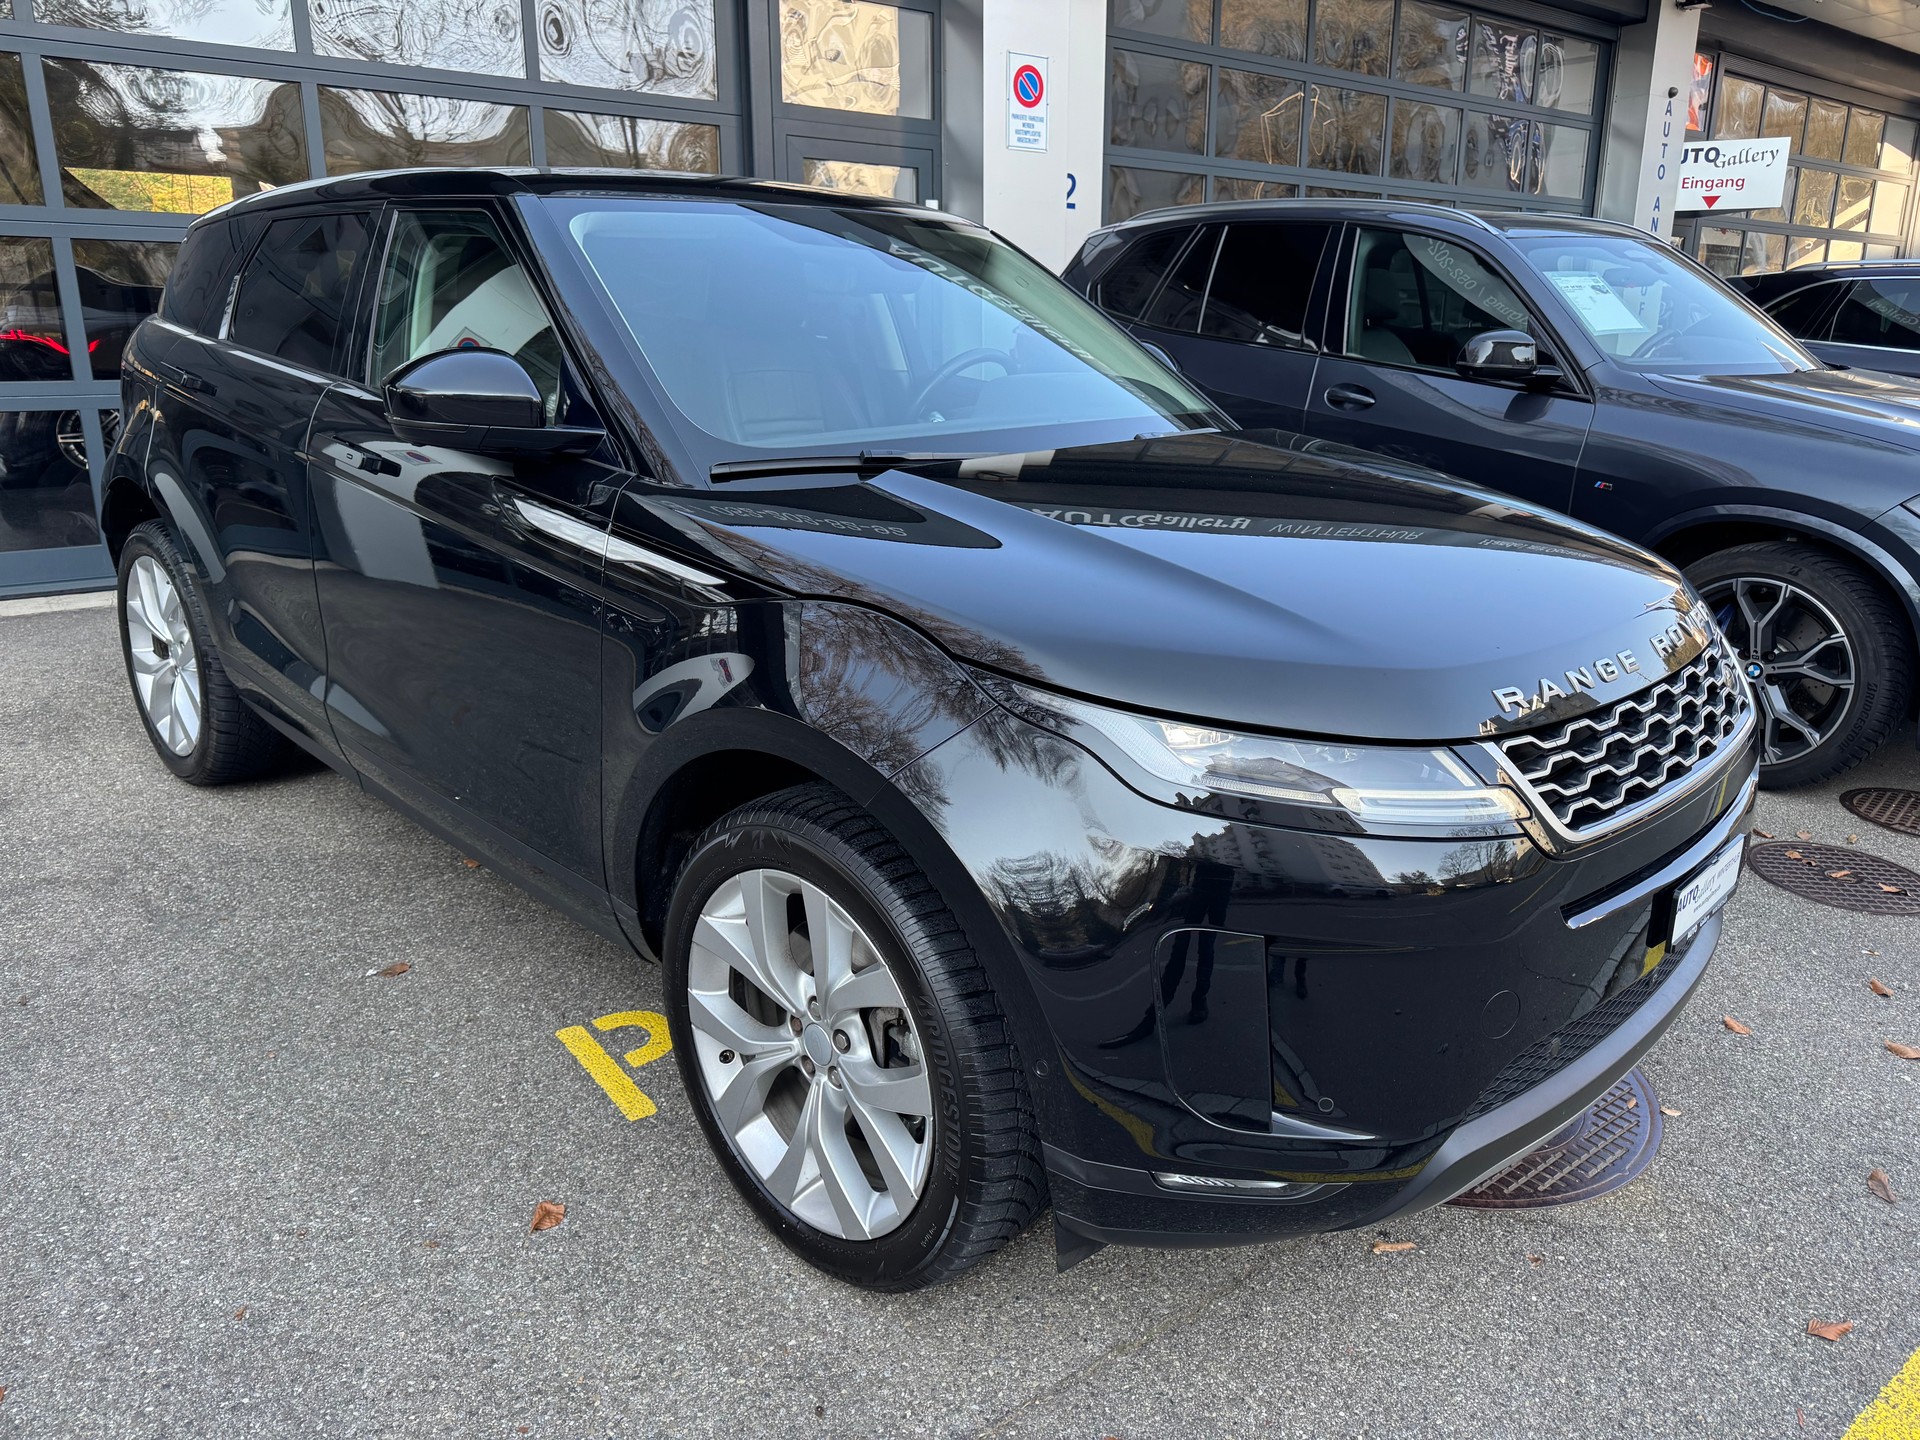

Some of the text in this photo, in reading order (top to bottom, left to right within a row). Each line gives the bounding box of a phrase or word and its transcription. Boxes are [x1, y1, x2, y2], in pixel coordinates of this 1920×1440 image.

[1657, 100, 1672, 180] AUTO
[1066, 172, 1077, 210] 2
[1681, 176, 1745, 191] Eingang
[1491, 648, 1640, 713] RANGE
[1838, 682, 1878, 752] BRIDGESTONE
[554, 1010, 673, 1122] P
[914, 992, 963, 1186] BRIDGESTONE
